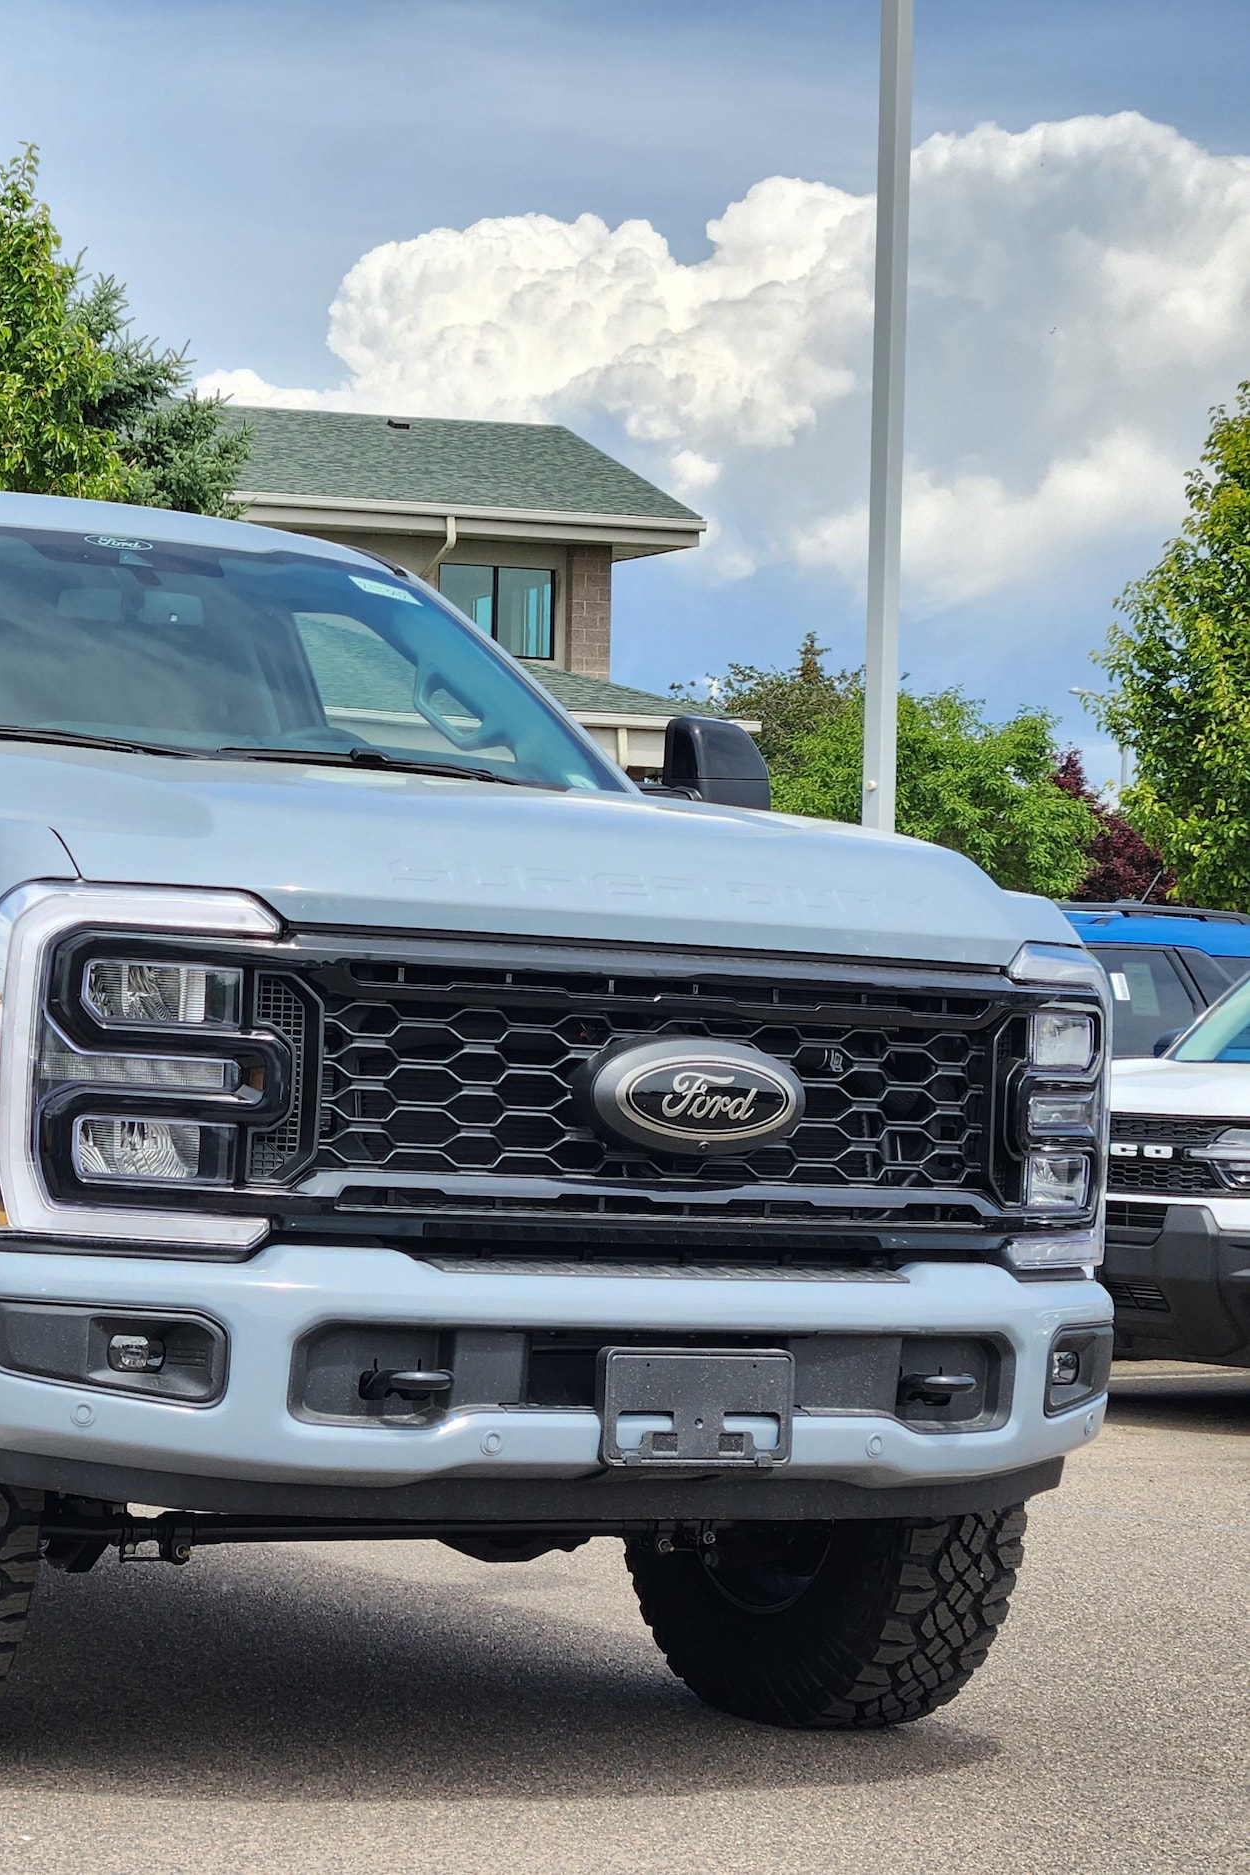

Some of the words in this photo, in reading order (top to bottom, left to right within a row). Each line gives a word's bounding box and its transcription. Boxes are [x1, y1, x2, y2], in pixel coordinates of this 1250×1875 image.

[97, 536, 142, 549] Ford
[388, 858, 709, 905] SUPER
[726, 879, 934, 919] DUTY
[661, 1071, 758, 1121] Ford
